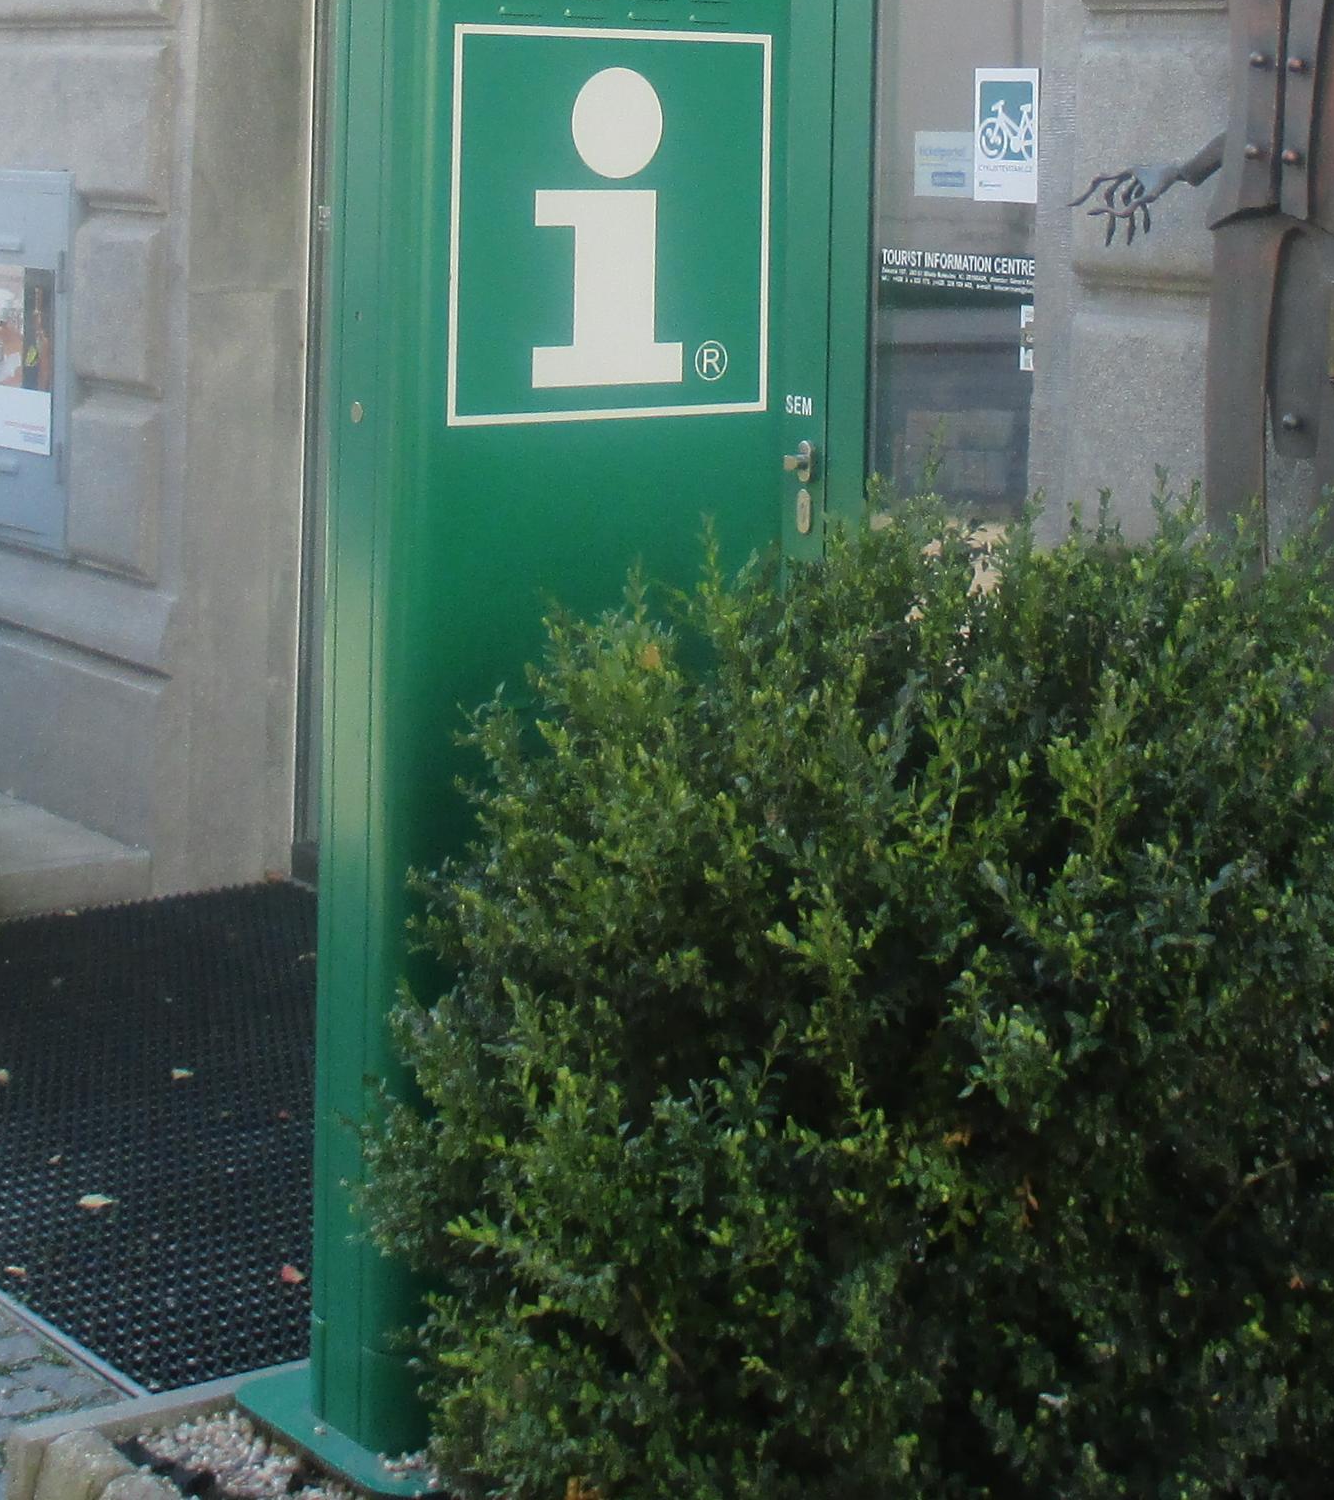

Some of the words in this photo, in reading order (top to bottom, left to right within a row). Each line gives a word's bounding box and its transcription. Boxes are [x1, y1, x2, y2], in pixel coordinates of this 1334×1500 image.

[532, 67, 683, 388] i
[882, 248, 923, 267] TOURIST
[924, 251, 992, 273] INFORMATION
[993, 257, 1035, 277] CENTRE
[785, 394, 813, 417] SEM
